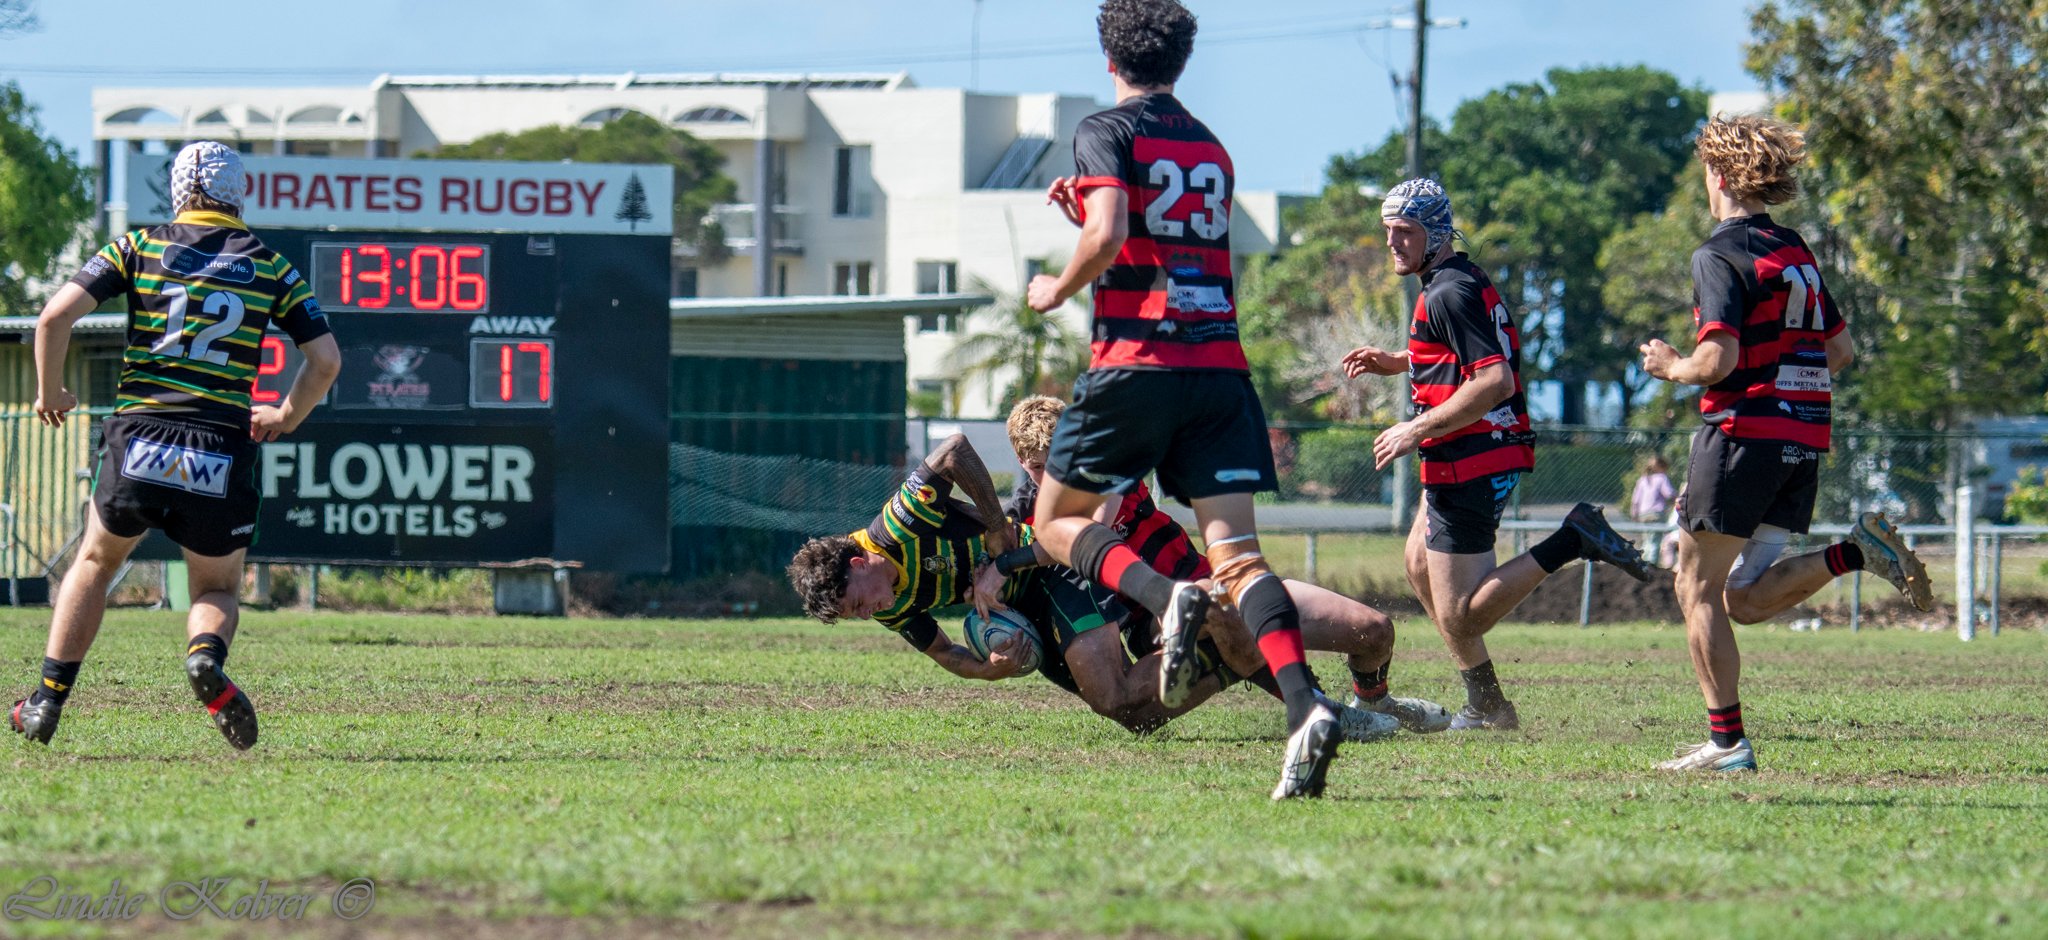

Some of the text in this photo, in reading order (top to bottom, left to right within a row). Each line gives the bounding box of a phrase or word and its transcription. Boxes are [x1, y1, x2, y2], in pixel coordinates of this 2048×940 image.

[440, 177, 606, 217] RUGBY
[1145, 158, 1228, 241] 23
[340, 245, 487, 310] 13:06
[150, 281, 245, 366] 12
[469, 316, 556, 335] AWAY
[500, 342, 550, 402] 17
[261, 442, 535, 502] FLOWER
[324, 503, 478, 537] HOTELS
